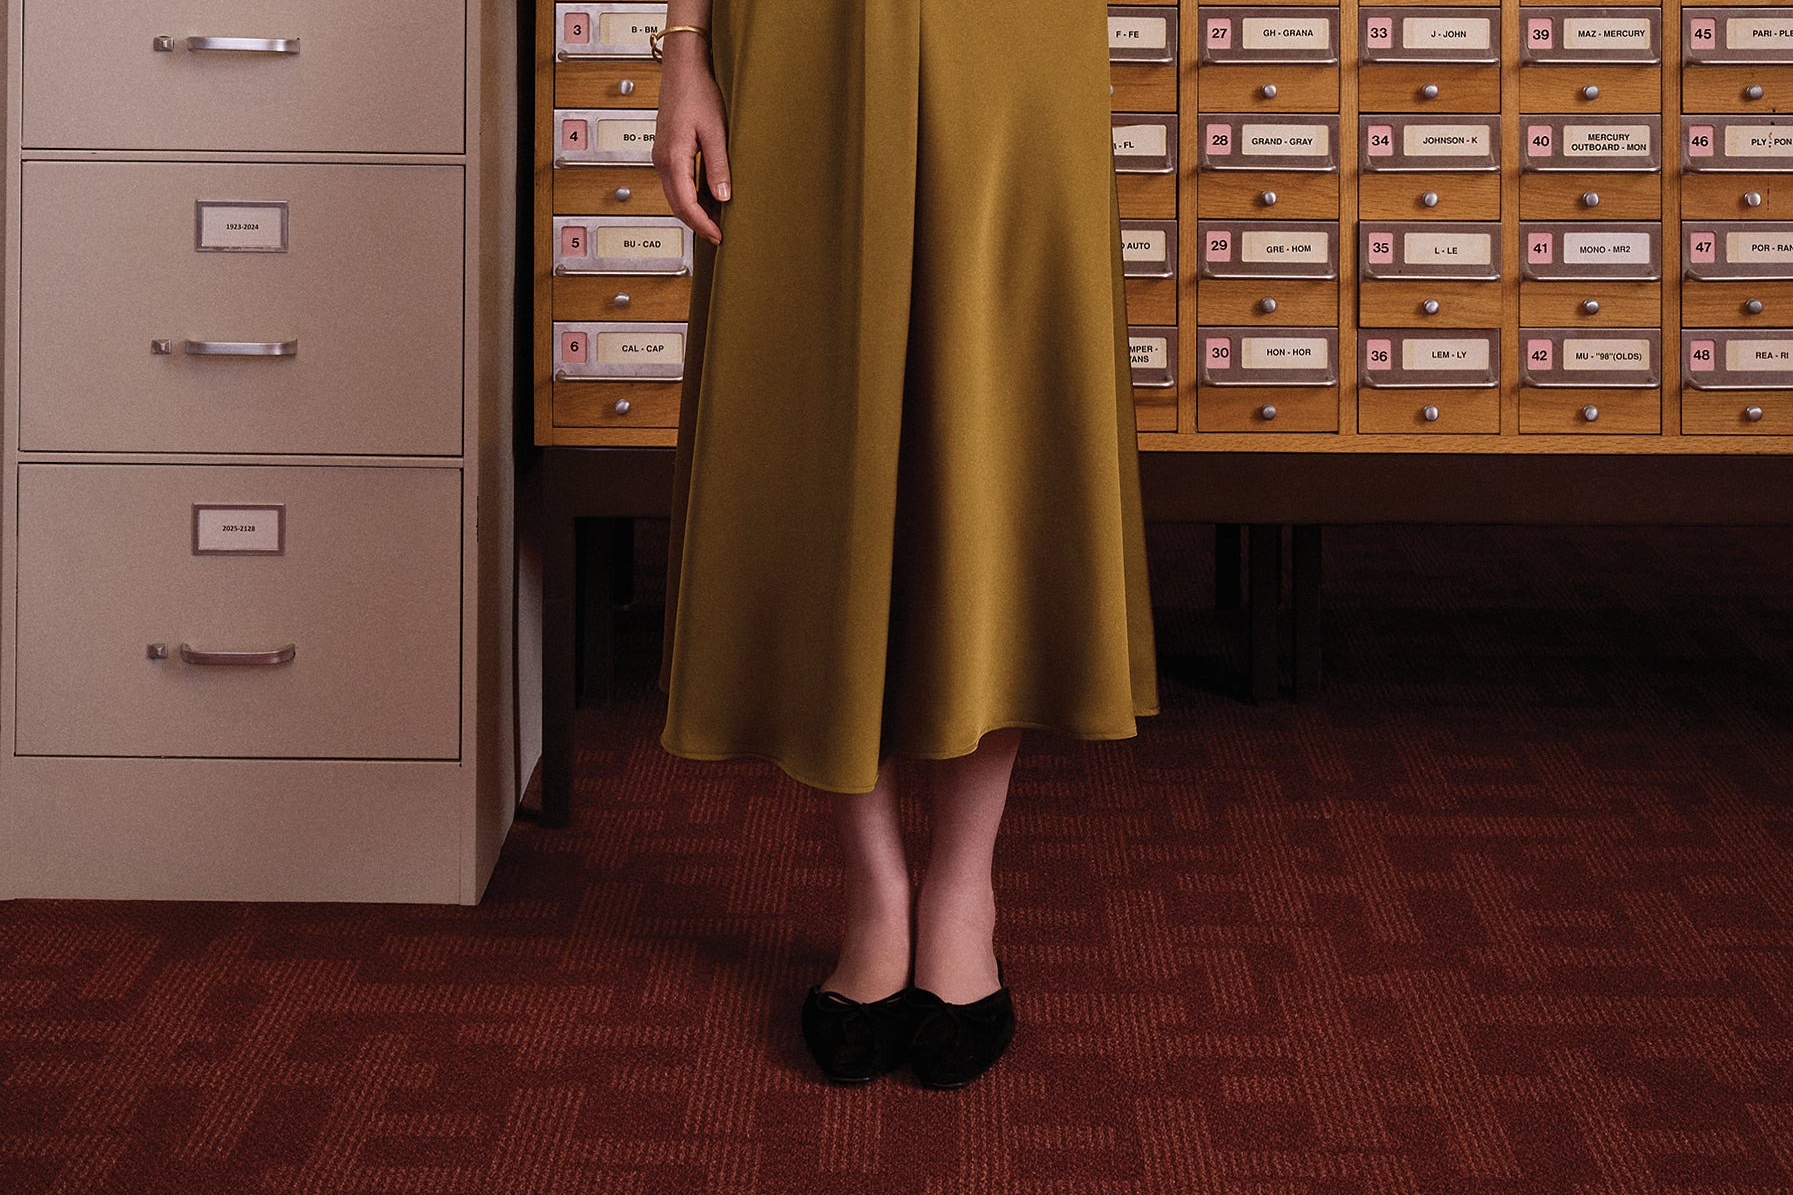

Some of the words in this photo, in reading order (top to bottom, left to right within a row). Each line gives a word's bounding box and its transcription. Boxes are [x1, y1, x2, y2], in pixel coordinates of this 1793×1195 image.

[572, 24, 582, 36] 3
[631, 25, 638, 34] B
[644, 25, 658, 34] BM
[1115, 30, 1122, 38] F
[1128, 30, 1140, 39] FE
[1211, 27, 1228, 39] 27
[1262, 28, 1276, 37] GH
[1282, 28, 1314, 38] GRANA
[1370, 27, 1388, 39] 33
[1430, 30, 1436, 38] J
[1442, 30, 1467, 39] JOHN
[1532, 28, 1550, 41] 39
[1577, 30, 1597, 38] MAZ
[1603, 29, 1646, 38] MERCURY
[1694, 28, 1712, 40] 45
[1752, 29, 1772, 38] PARI
[569, 130, 579, 142] 4
[623, 133, 637, 142] BO
[642, 133, 656, 143] BR
[1211, 134, 1229, 146] 28
[1371, 134, 1390, 147] 34
[1422, 136, 1465, 145] JOHNSON
[1471, 136, 1478, 144] K
[1532, 135, 1550, 147] 40
[1587, 133, 1630, 142] MERCURY
[1123, 141, 1135, 149] FL
[1251, 137, 1283, 146] GRAND
[1288, 137, 1313, 146] GRAY
[1691, 135, 1709, 148] 46
[1750, 138, 1767, 146] PLY
[1773, 138, 1793, 146] PON
[1570, 143, 1620, 152] OUTBOARD
[1626, 143, 1647, 152] MON
[226, 223, 259, 231] 1923-2024
[571, 237, 580, 249] 5
[623, 240, 636, 248] BU
[642, 240, 662, 249] CAD
[1126, 241, 1151, 250] AUTO
[1210, 239, 1228, 252] 29
[1372, 241, 1390, 254] 35
[1532, 242, 1548, 254] 41
[1695, 241, 1712, 253] 47
[1751, 243, 1770, 252] POR
[1265, 245, 1285, 254] GRE
[1291, 244, 1312, 253] HOM
[1434, 247, 1440, 255] L
[1446, 246, 1458, 255] LE
[1579, 245, 1606, 254] MONO
[1612, 245, 1631, 253] MR2
[569, 340, 579, 353] 6
[621, 344, 640, 353] CAL
[645, 344, 665, 353] CAP
[1211, 347, 1230, 359] 30
[1266, 348, 1286, 357] HON
[1292, 348, 1312, 357] HOR
[1370, 350, 1388, 363] 36
[1431, 350, 1450, 359] LEM
[1456, 351, 1467, 359] LY
[1531, 349, 1548, 362] 42
[1575, 352, 1589, 361] MU
[1693, 349, 1711, 361] 48
[1755, 351, 1774, 360] REA
[1780, 351, 1789, 360] RI
